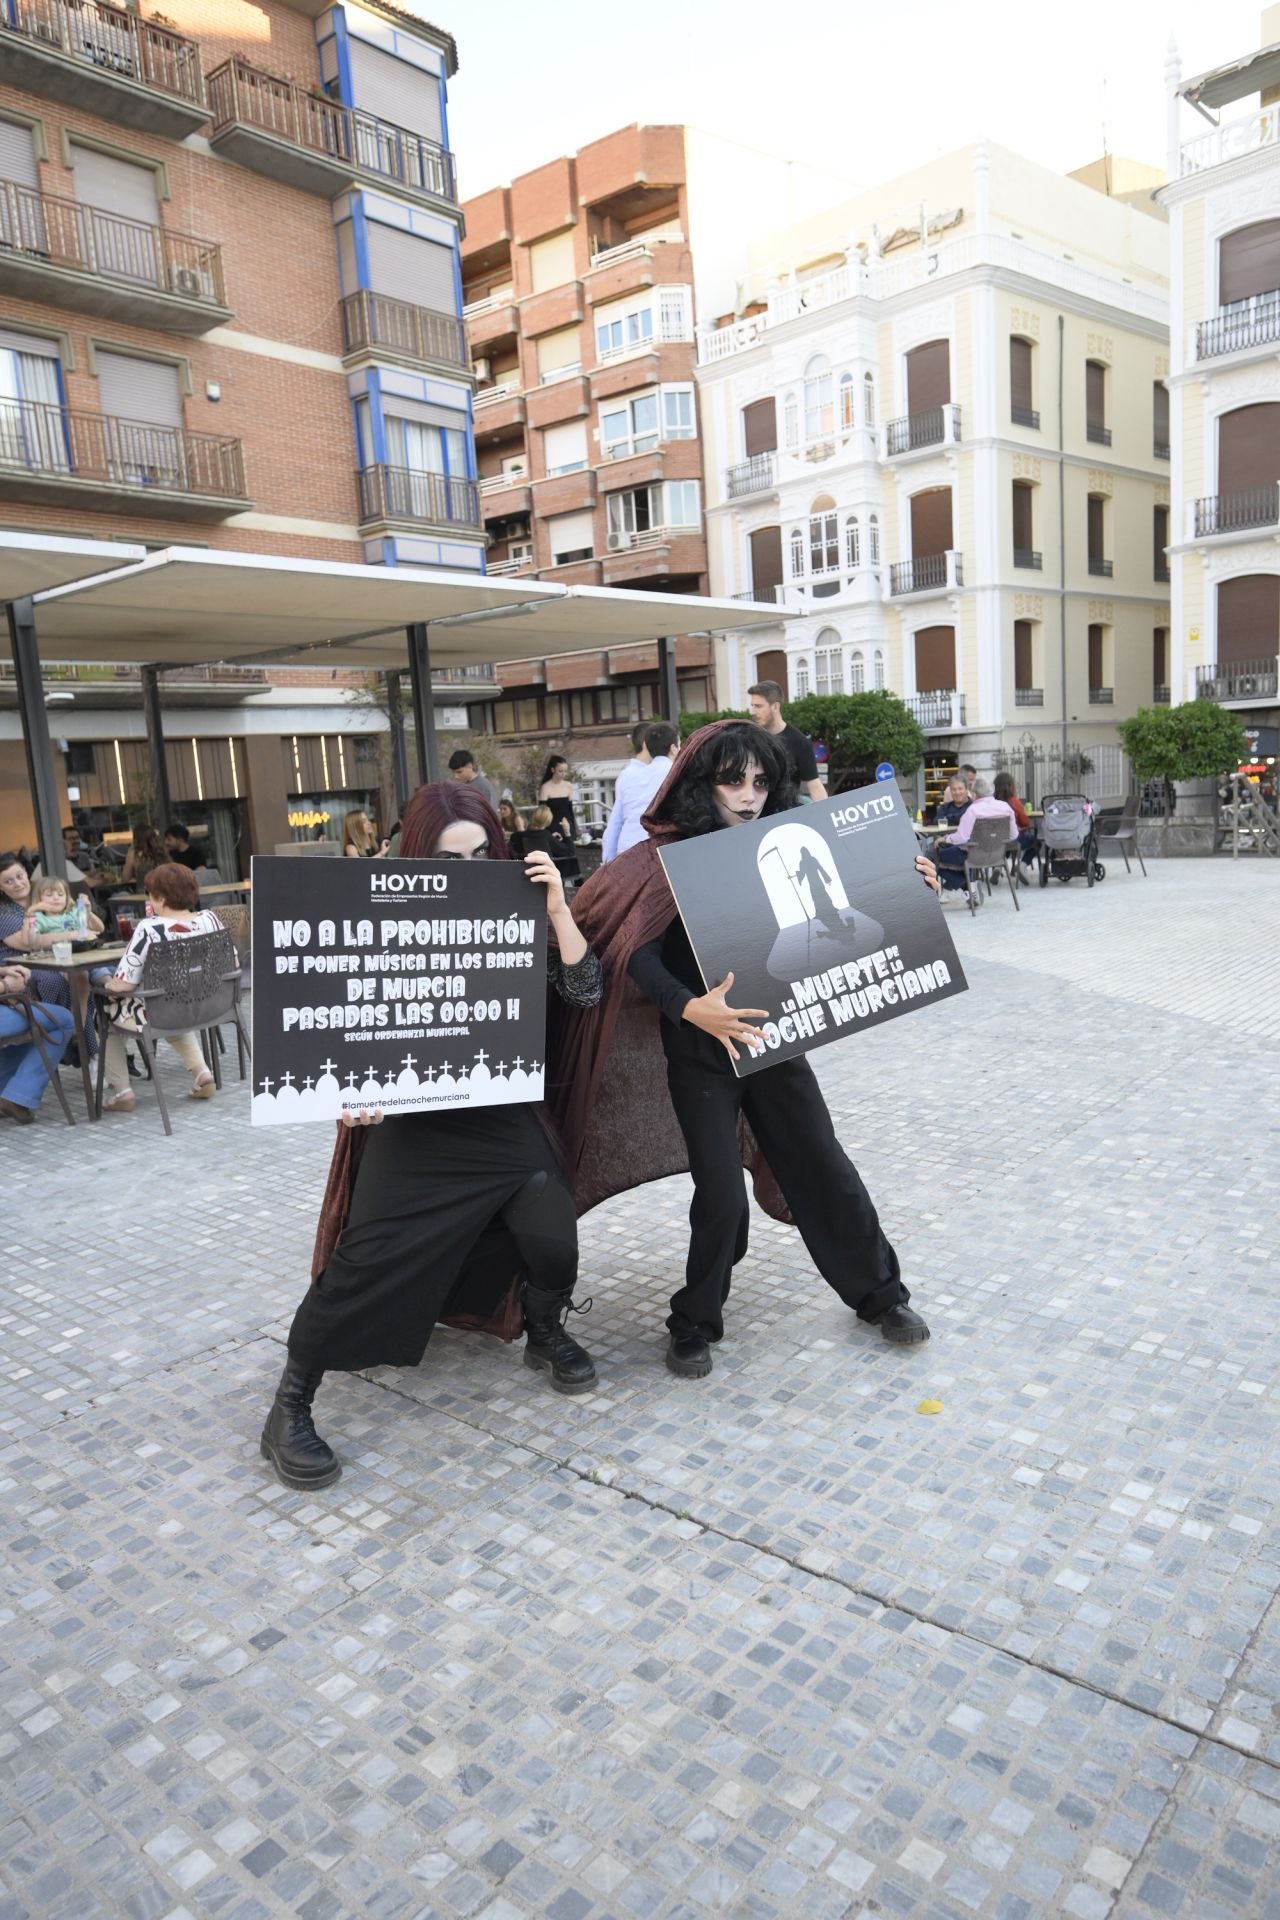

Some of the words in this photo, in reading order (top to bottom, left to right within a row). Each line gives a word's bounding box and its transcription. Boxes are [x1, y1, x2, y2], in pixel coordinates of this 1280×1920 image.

[273, 920, 311, 948] NO
[318, 920, 335, 946] A
[343, 920, 373, 947] LA
[381, 912, 535, 946] PROHIBICIÓN
[276, 956, 298, 974] DE
[303, 955, 360, 973] PONER
[364, 950, 426, 973] MÚSICA
[430, 953, 451, 971] EN
[455, 953, 482, 970] LOS
[486, 951, 533, 968] BARES
[884, 945, 900, 960] DE
[890, 958, 905, 974] LA
[347, 978, 376, 1001] DE
[382, 975, 465, 1001] MURCIA
[790, 949, 890, 1010] MUERTE
[283, 1004, 389, 1031] PASADAS
[395, 1001, 434, 1025] LAS
[440, 1000, 501, 1023] 00:00
[507, 998, 520, 1020] H
[744, 1003, 827, 1058] NOCHE
[828, 959, 951, 1027] MURCIANA
[781, 998, 797, 1014] LA
[344, 1029, 373, 1042] SEGÚN
[374, 1029, 424, 1040] ORDENANZA
[426, 1027, 470, 1038] MUNICIPAL
[341, 1093, 470, 1109] #lamuertedelanochemurciana
